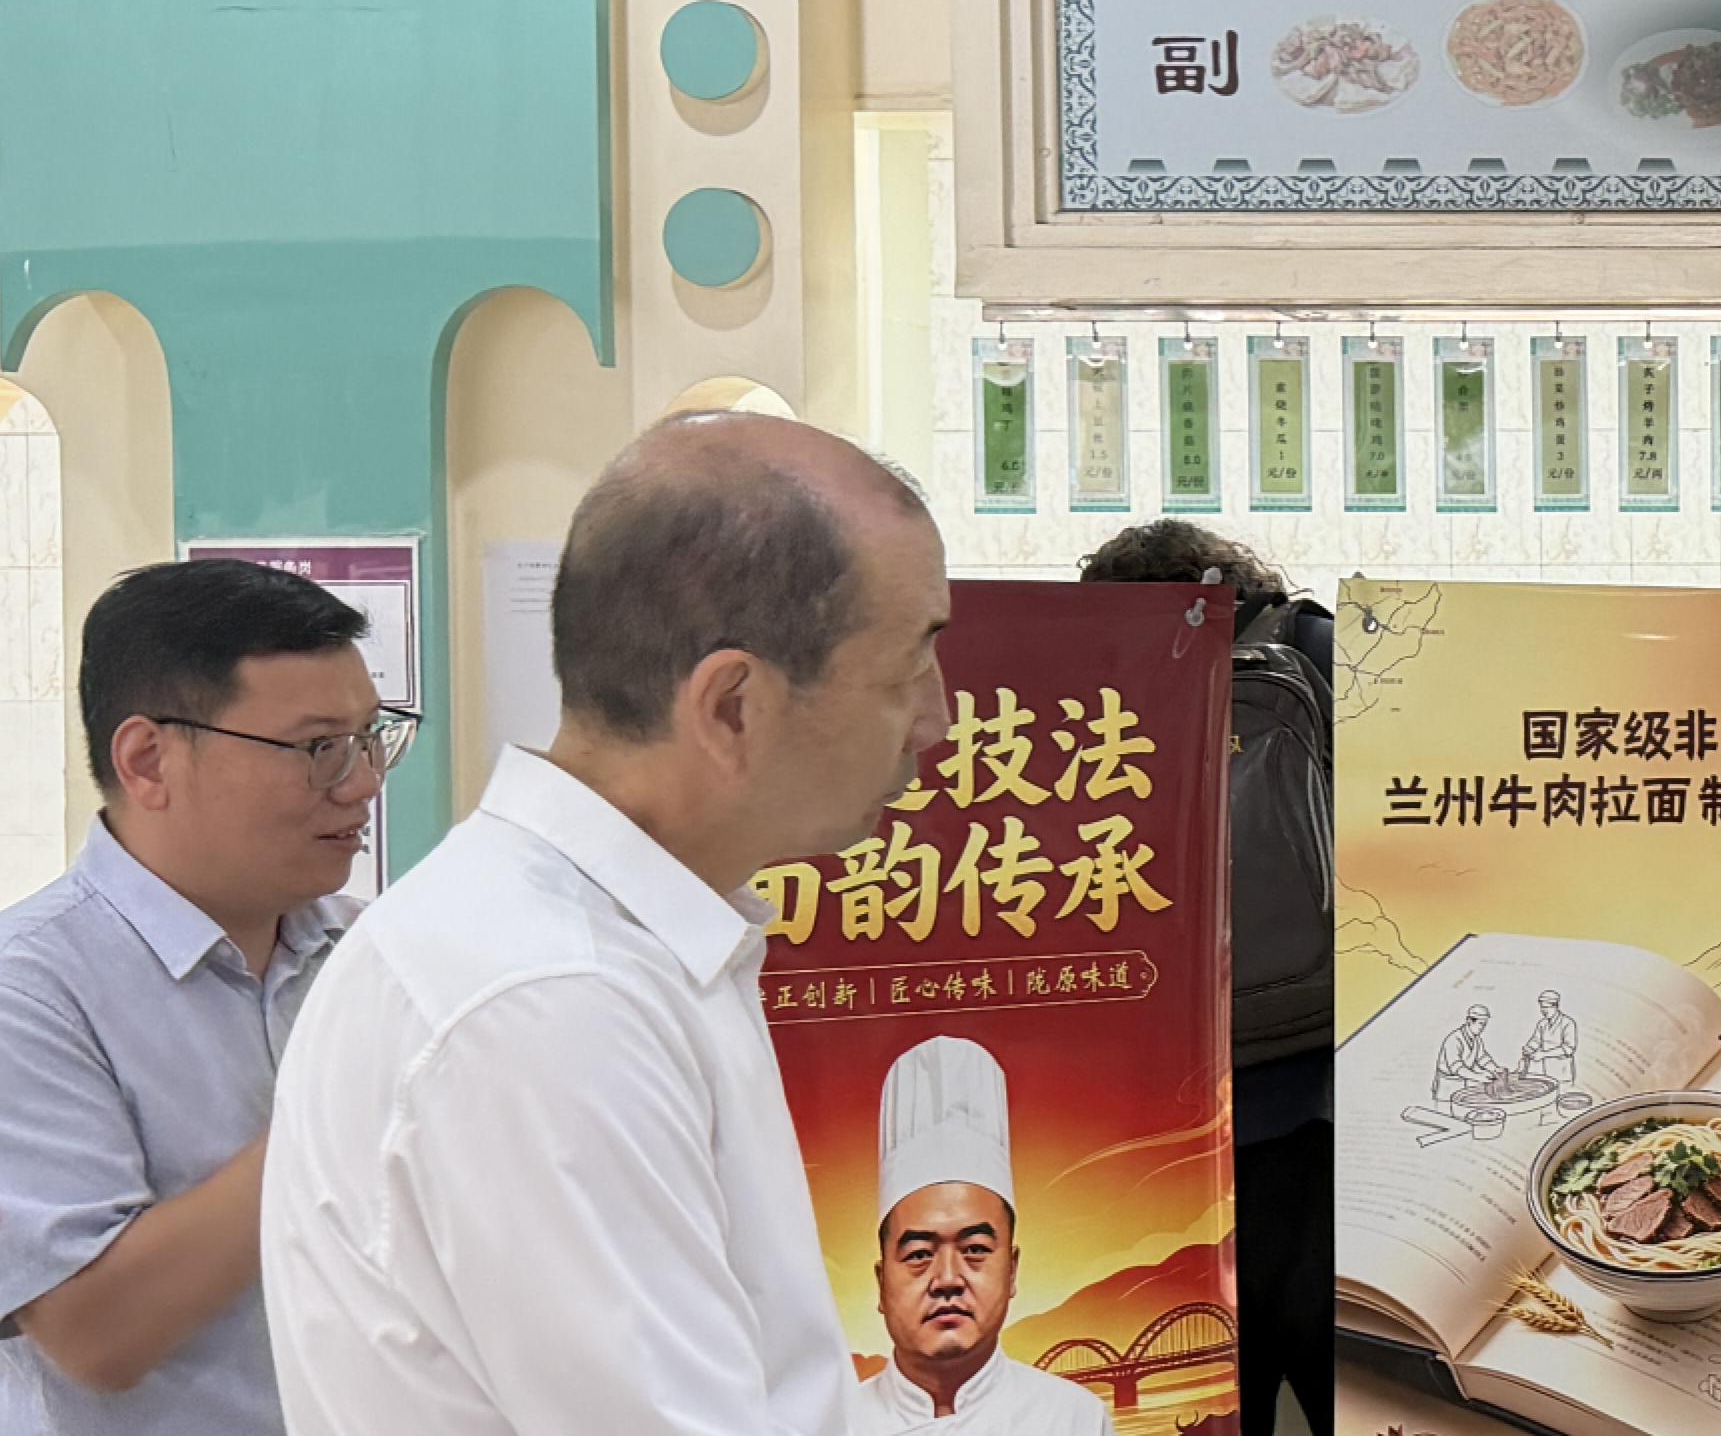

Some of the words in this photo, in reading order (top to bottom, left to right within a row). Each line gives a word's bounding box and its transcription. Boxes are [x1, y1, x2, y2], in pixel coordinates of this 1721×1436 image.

[1152, 30, 1240, 97] 副
[885, 686, 1157, 812] 技法
[760, 977, 858, 1011] 正创新
[1025, 962, 1132, 997] 陇原味道
